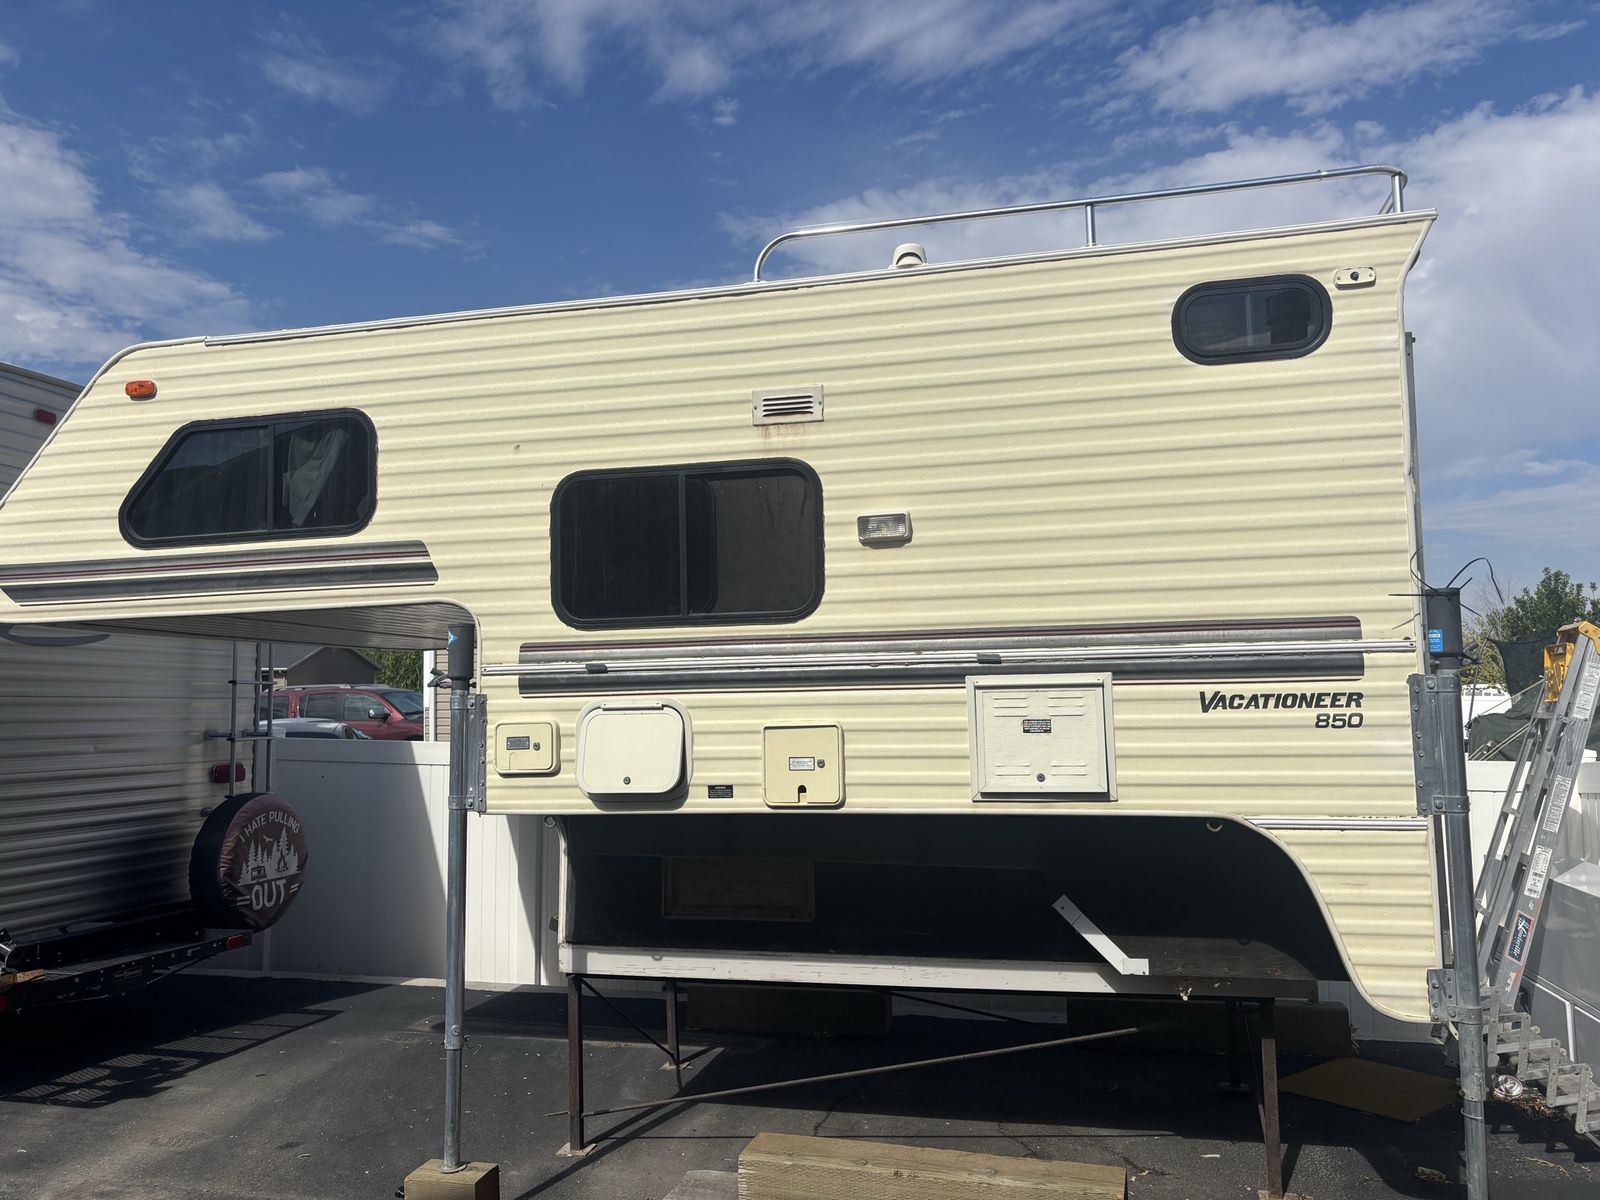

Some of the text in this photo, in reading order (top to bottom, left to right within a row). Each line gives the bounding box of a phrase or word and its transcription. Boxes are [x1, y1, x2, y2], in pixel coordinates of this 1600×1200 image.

[1199, 690, 1364, 713] VACATIONEER
[1314, 712, 1364, 729] 850
[244, 813, 267, 837] HATE
[269, 811, 300, 833] PULLING
[251, 879, 286, 910] OUT
